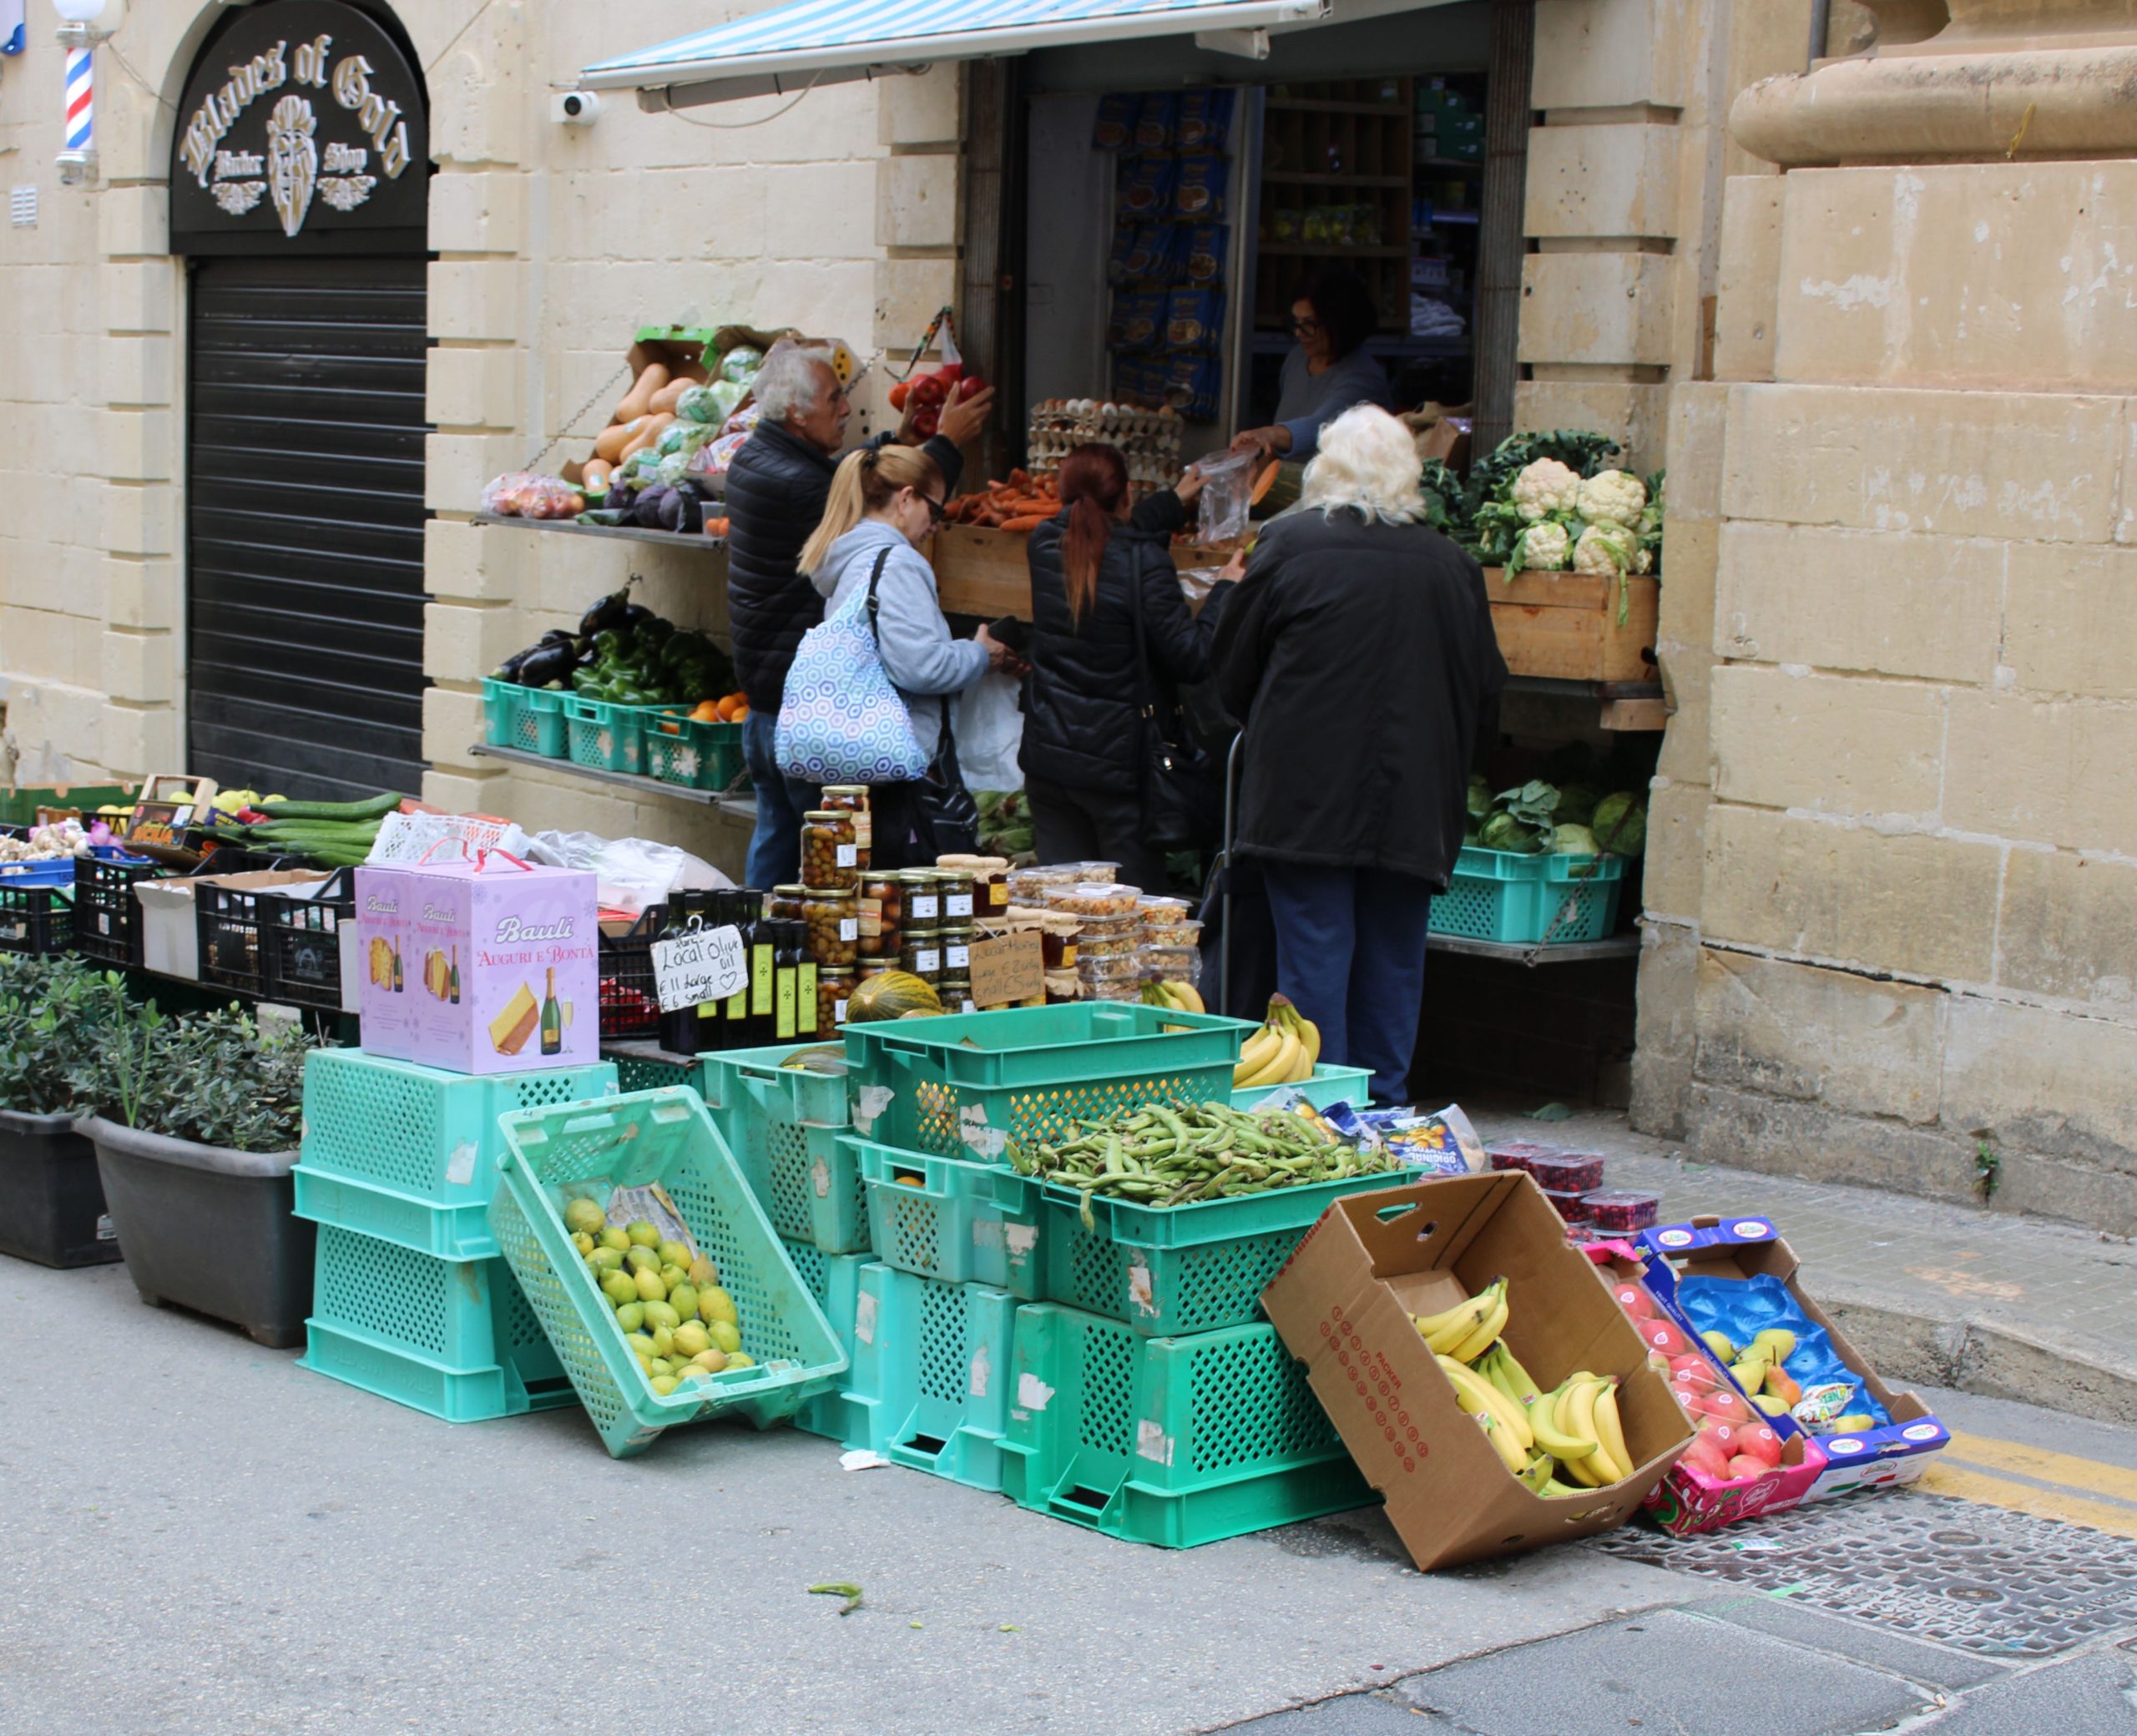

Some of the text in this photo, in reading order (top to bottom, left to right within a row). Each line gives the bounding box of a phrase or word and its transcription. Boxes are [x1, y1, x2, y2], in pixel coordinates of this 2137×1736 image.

[179, 33, 412, 188] Blades of Gold
[323, 142, 367, 174] Shop
[367, 894, 398, 915] Bauli
[423, 902, 456, 923] Bauli
[495, 915, 575, 945] Bauli
[477, 950, 533, 967] AUGURI
[537, 951, 544, 963] E
[663, 941, 704, 971] Local
[707, 936, 739, 960] Olive
[1376, 1350, 1402, 1390] PACKER
